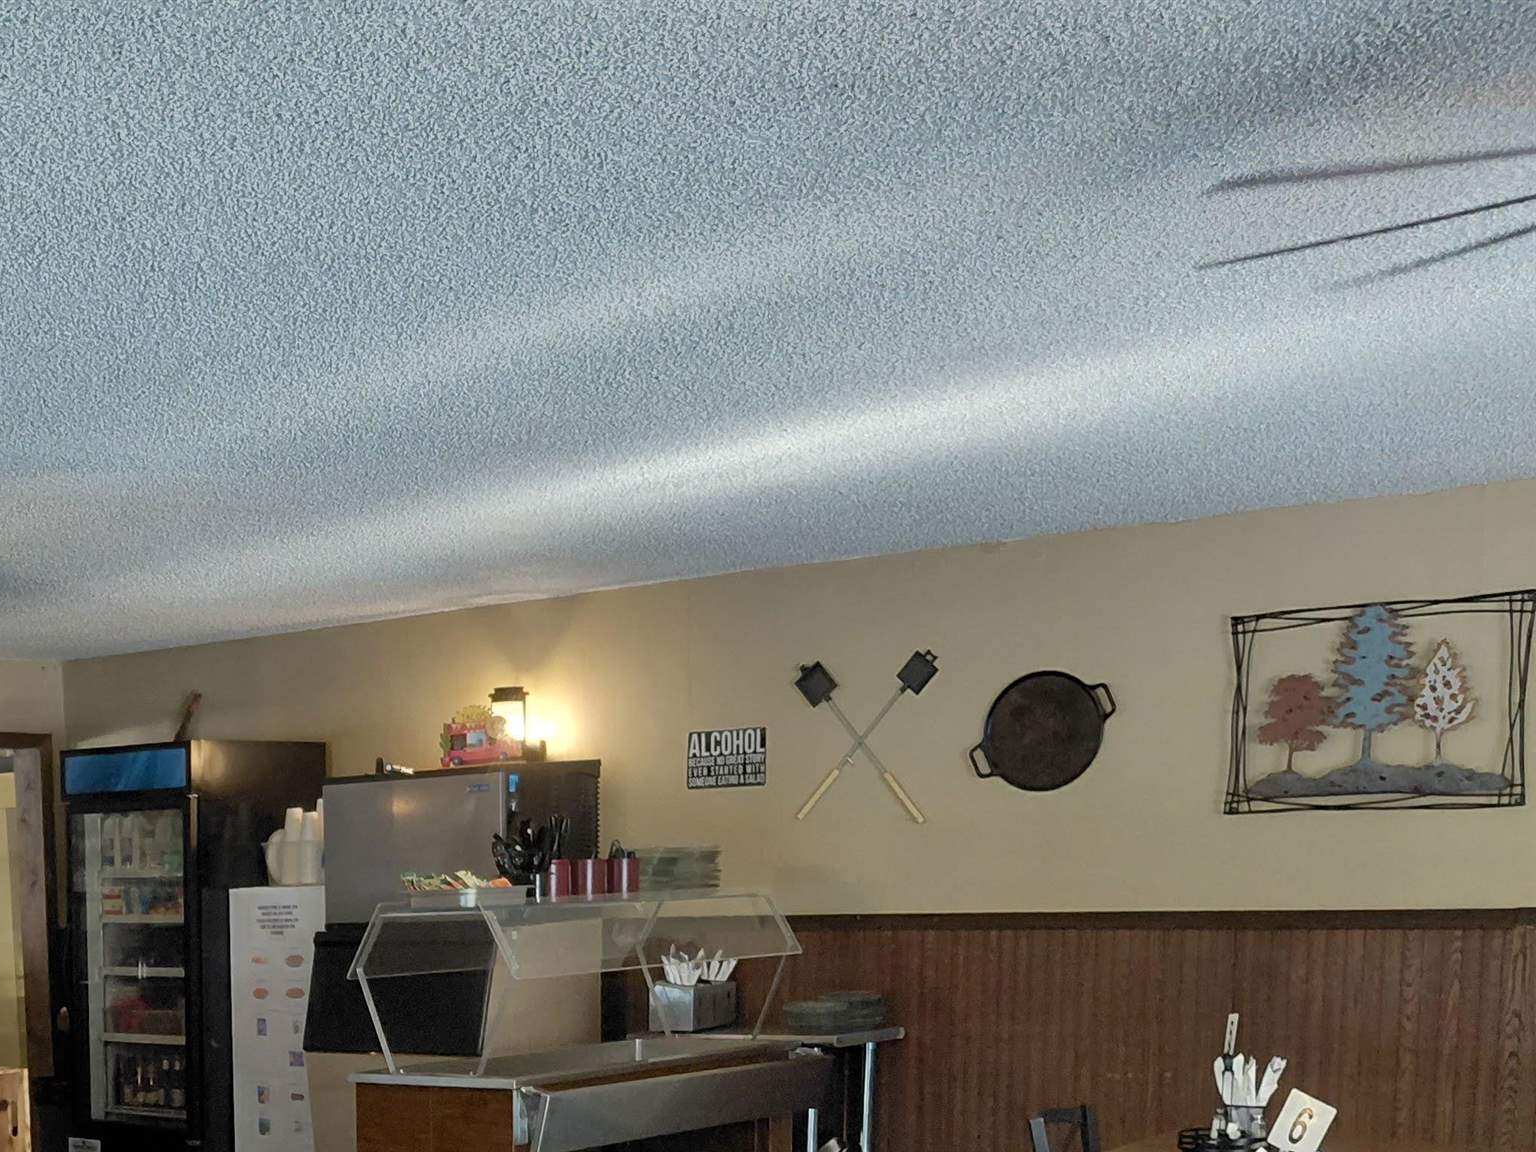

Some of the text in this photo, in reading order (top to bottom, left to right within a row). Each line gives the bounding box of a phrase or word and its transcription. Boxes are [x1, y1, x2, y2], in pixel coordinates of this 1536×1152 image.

[689, 728, 765, 757] ALCOHOL
[688, 757, 715, 767] BECAUSE
[716, 756, 724, 765] NO
[688, 763, 765, 777] EVER STARTED WITH
[688, 776, 717, 787] SOMEONE
[1288, 1107, 1314, 1145] 6
